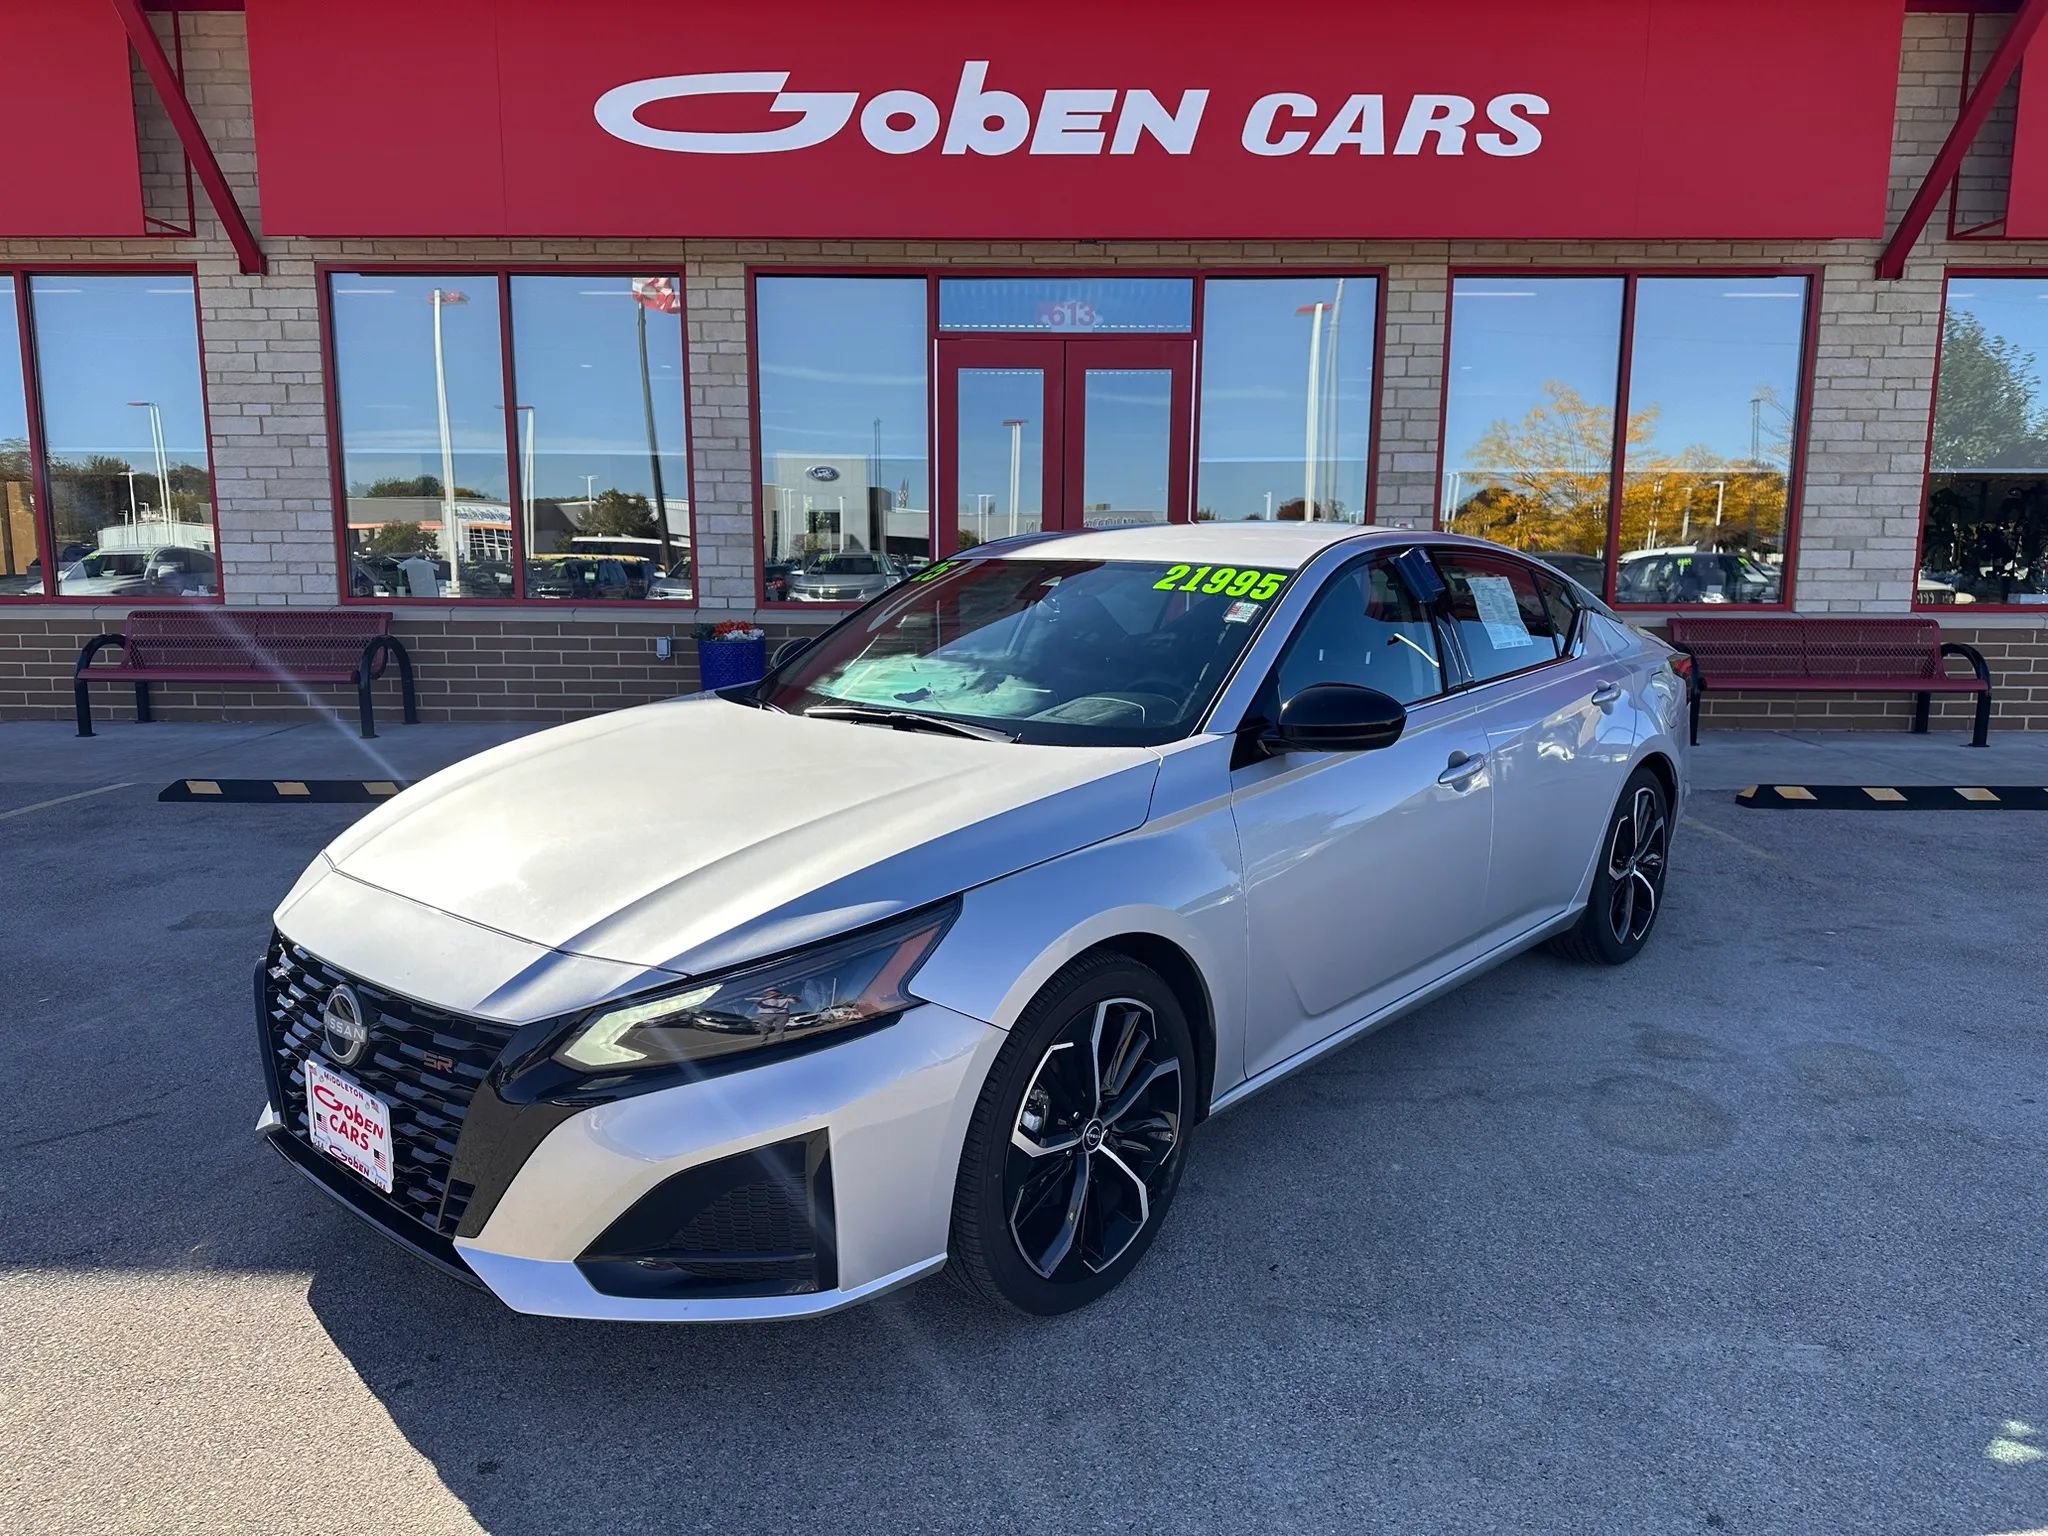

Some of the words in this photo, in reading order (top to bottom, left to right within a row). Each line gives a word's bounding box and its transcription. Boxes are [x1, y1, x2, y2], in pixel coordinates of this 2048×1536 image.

[1241, 92, 1550, 156] CARS
[1153, 565, 1288, 600] 21995
[423, 1051, 454, 1074] SR
[323, 1071, 364, 1101] MIDDLETON
[329, 1113, 369, 1151] CARS
